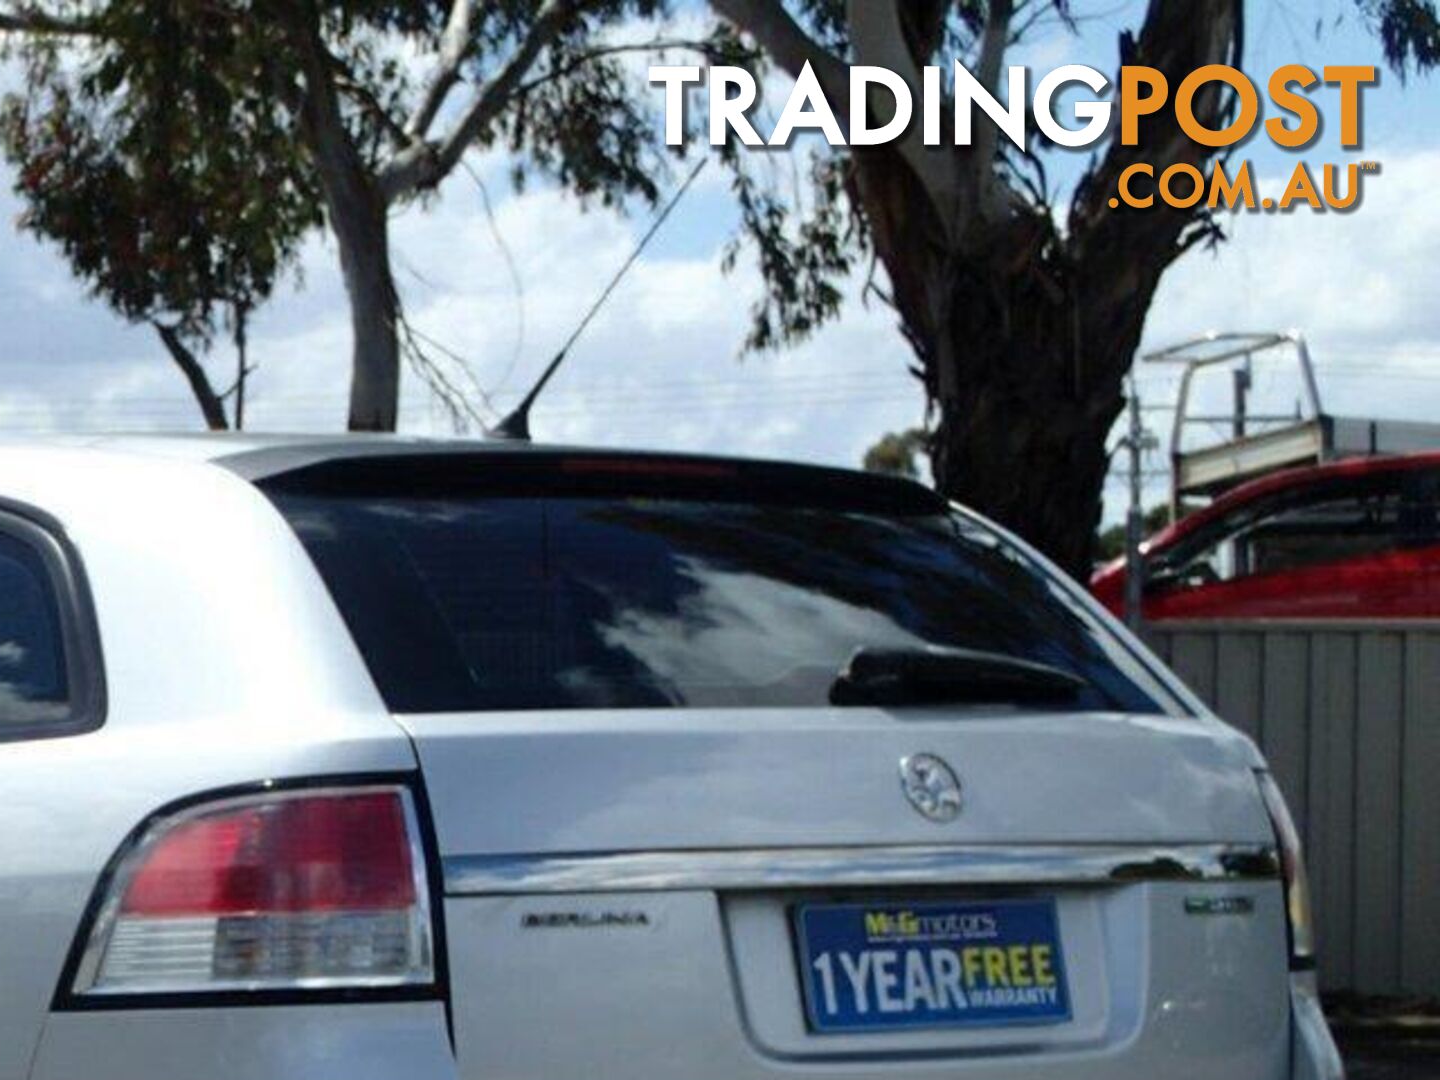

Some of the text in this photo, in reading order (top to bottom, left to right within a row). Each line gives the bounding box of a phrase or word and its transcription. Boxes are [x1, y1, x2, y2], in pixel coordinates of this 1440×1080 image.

[838, 949, 968, 1013] YEAR
[962, 945, 1056, 987] FREE
[968, 986, 1058, 1008] WARRANTY
